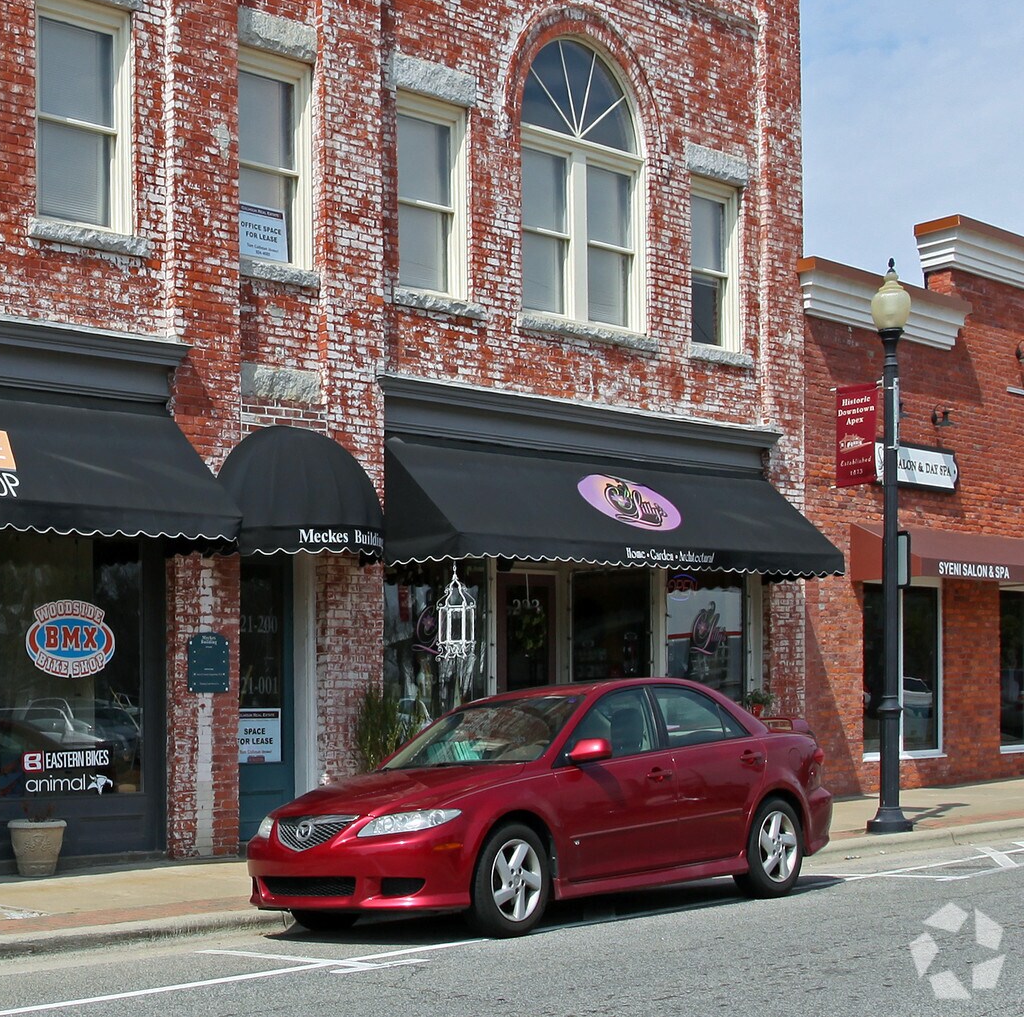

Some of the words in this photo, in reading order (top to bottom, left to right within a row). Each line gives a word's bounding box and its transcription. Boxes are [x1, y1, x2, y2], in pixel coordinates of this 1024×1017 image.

[240, 221, 262, 231] OFFICE
[263, 226, 282, 235] SPACE
[245, 231, 258, 239] FOR
[259, 234, 278, 243] LEASE
[841, 395, 871, 406] Historic
[837, 405, 875, 417] Downtown
[846, 417, 864, 426] Apex
[897, 459, 916, 472] ALON
[918, 463, 924, 472] &
[925, 463, 939, 475] DAY
[939, 465, 952, 477] SPA
[298, 529, 349, 543] Meckes
[625, 547, 646, 559] Home
[649, 549, 674, 562] Garden
[938, 561, 962, 575] SYENI
[962, 564, 988, 577] SALON
[988, 565, 994, 578] &
[995, 566, 1010, 579] SPA
[36, 601, 104, 624] WOODSIDE
[44, 625, 98, 650] BMX
[37, 652, 69, 675] BIKE
[71, 652, 105, 675] SHOP
[240, 676, 279, 694] 21-001
[45, 751, 84, 769] EASTERN
[85, 750, 110, 766] BIKES
[25, 773, 86, 792] animal
